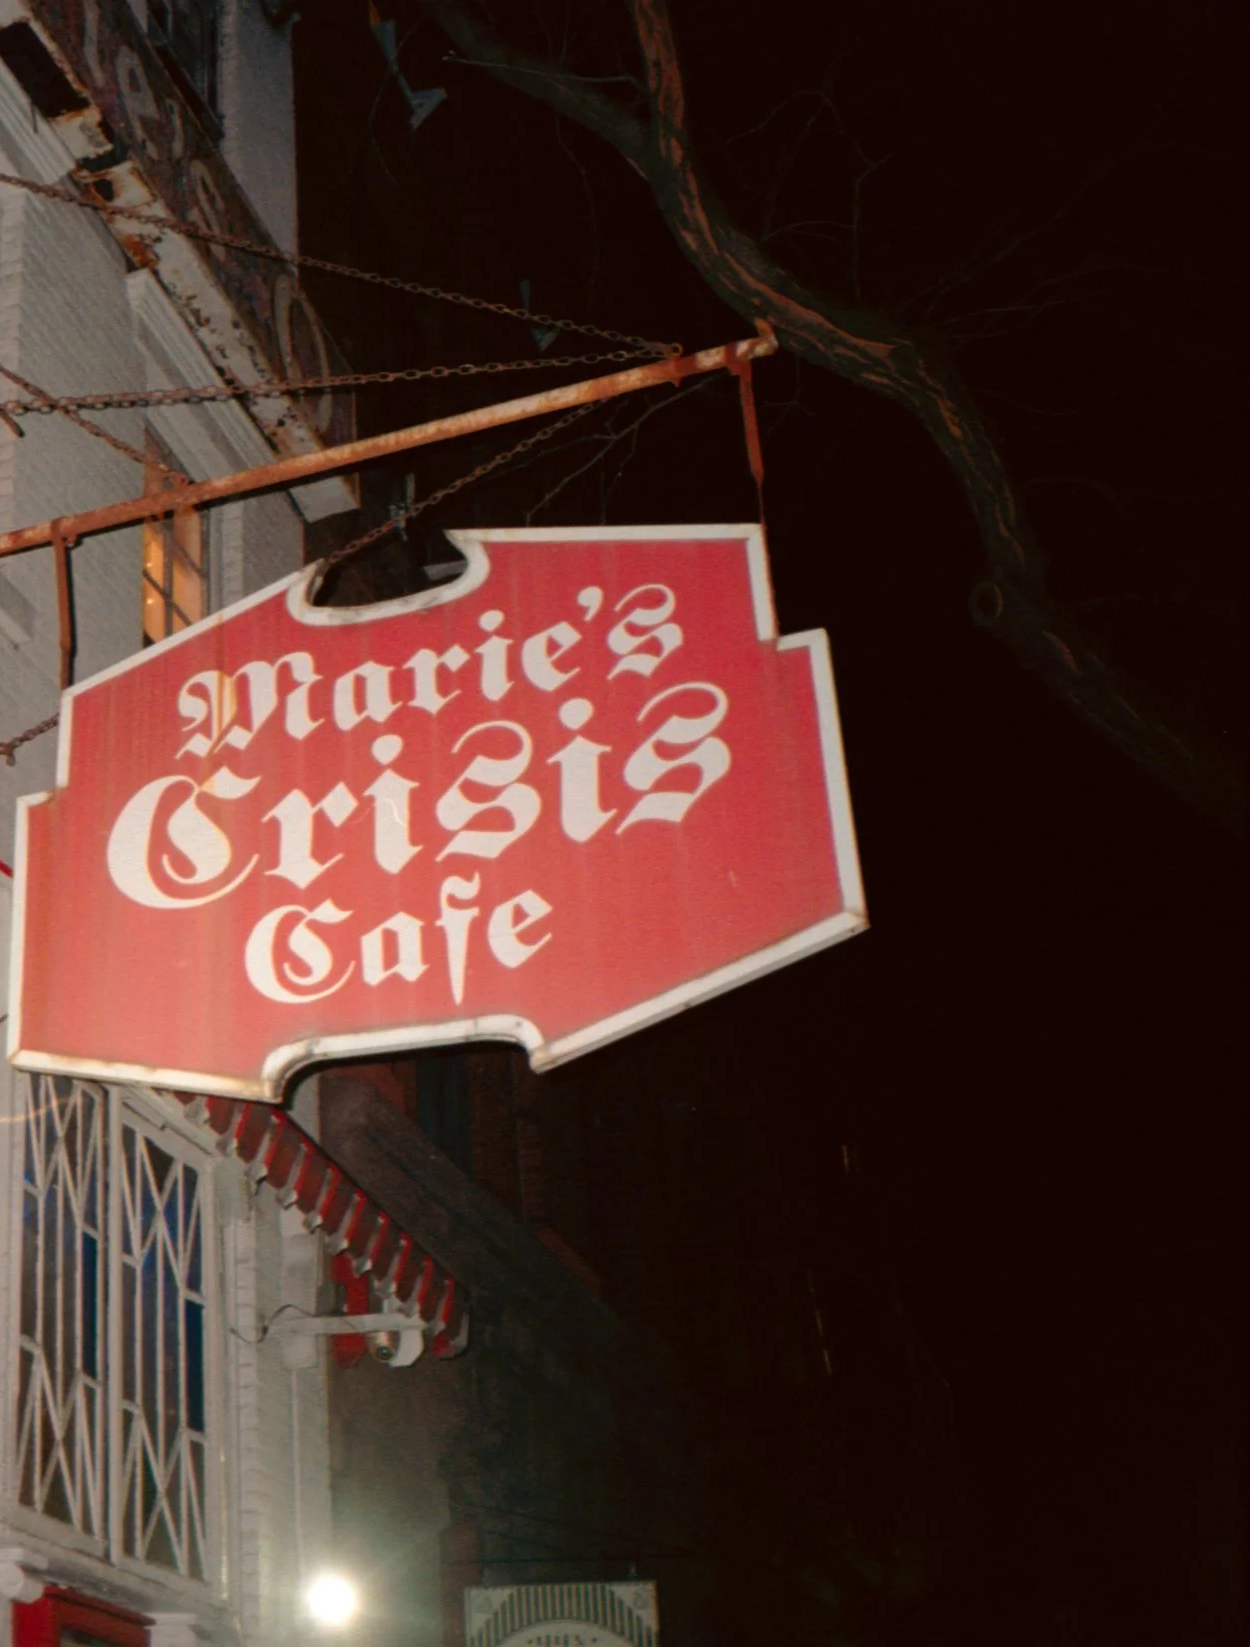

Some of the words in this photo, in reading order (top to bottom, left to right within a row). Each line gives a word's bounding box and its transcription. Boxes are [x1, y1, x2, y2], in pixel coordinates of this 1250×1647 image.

[175, 584, 683, 760] Marie's
[106, 682, 731, 910] Crisis
[244, 871, 553, 1006] Cafe
